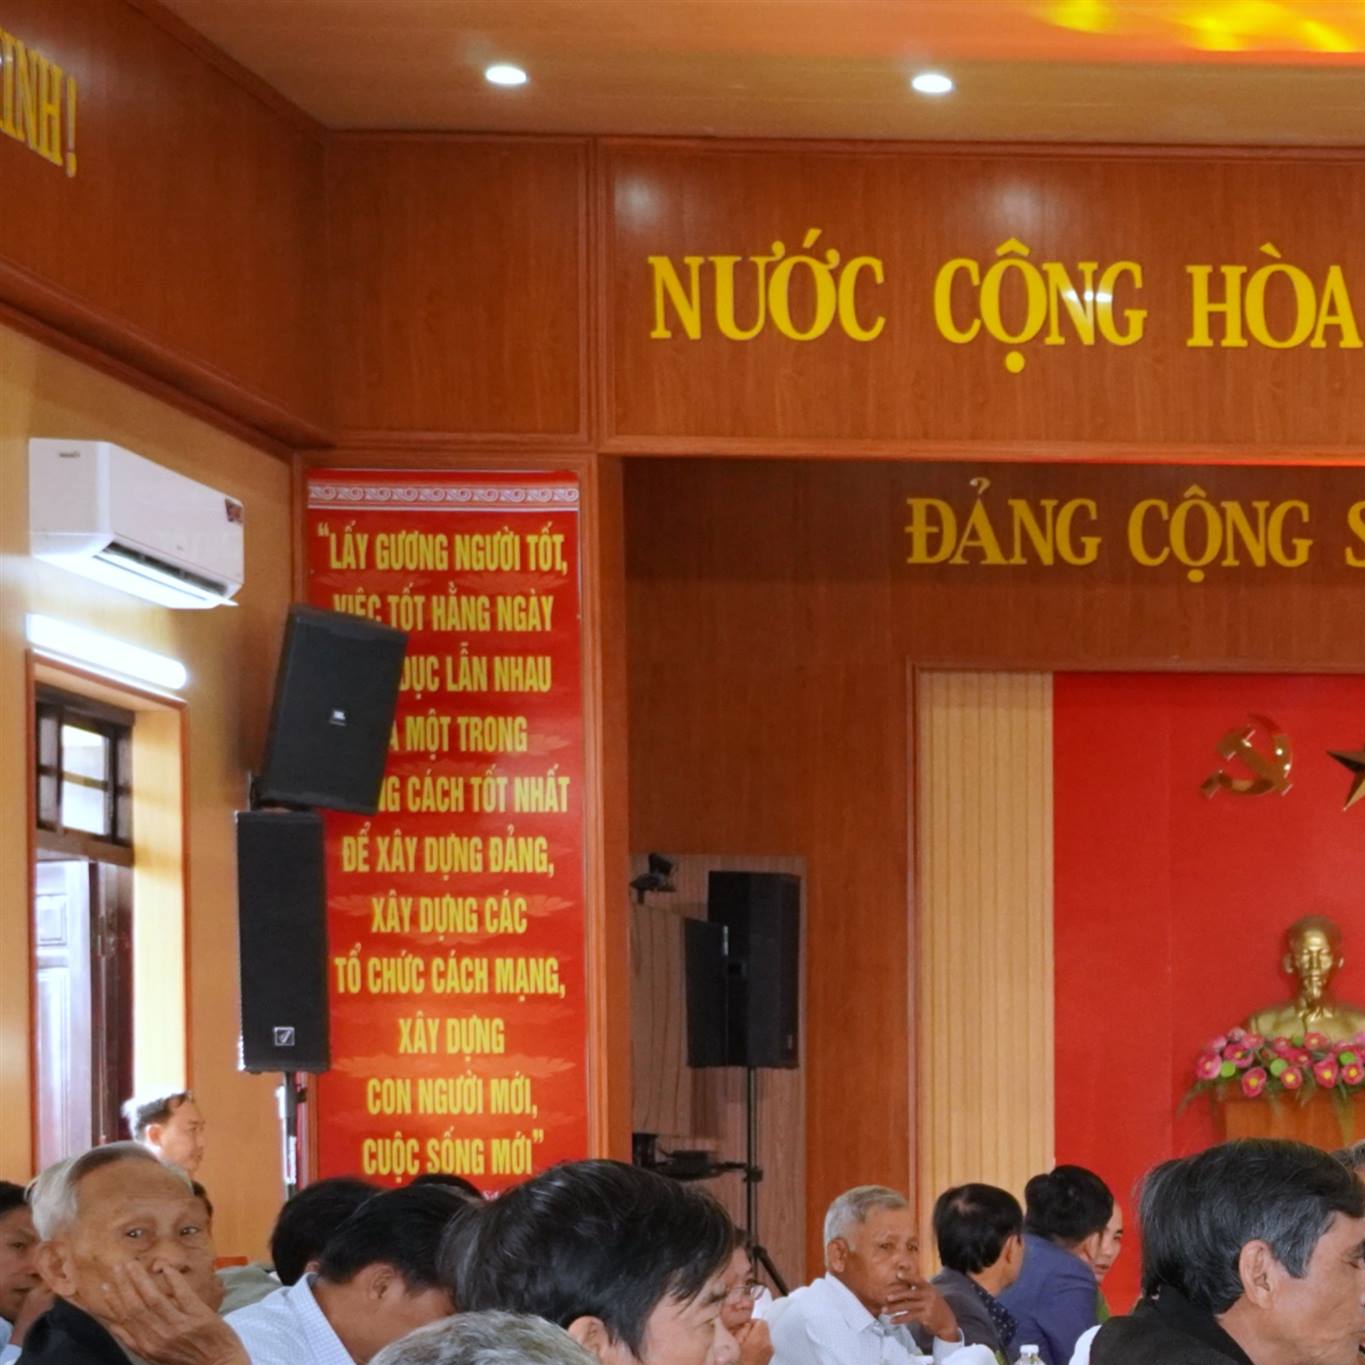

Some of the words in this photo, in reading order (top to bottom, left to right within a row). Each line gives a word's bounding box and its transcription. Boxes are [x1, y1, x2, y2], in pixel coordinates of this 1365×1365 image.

[648, 228, 885, 343] NƯỚC
[932, 237, 1148, 374] CỘNG
[1187, 243, 1363, 350] HÒA
[375, 527, 449, 572] GƯƠNG
[454, 525, 521, 572] NGƯỜI
[526, 521, 568, 576] TỐT,
[907, 476, 1100, 568] ĐẢNG
[1127, 485, 1312, 583] CỘNG
[387, 581, 426, 631] TỐT
[496, 587, 555, 632] NGÀY
[446, 641, 488, 692] LẪN
[494, 656, 553, 692] NHAU
[405, 708, 452, 760] MỘT
[457, 716, 529, 752] TRONG
[407, 769, 465, 812] CÁCH
[470, 764, 507, 813] TỐT
[513, 763, 571, 813] NHẤT
[376, 829, 418, 872] XÂY
[423, 832, 483, 880] DỰNG
[488, 825, 555, 877] ĐẢNG,
[371, 890, 413, 933] XÂY
[419, 894, 478, 941] DỰNG
[484, 890, 527, 933] CÁC
[367, 950, 425, 994] CHỨC
[430, 950, 488, 994] CÁCH
[495, 957, 566, 1002] MẠNG,
[398, 1010, 440, 1053] XÂY
[446, 1014, 505, 1062] DỰNG
[366, 1078, 411, 1115] CON
[418, 1070, 483, 1115] NGƯỜI
[490, 1071, 538, 1118] MỚI,
[362, 1132, 419, 1182] CUỘC
[426, 1126, 485, 1175] SỐNG
